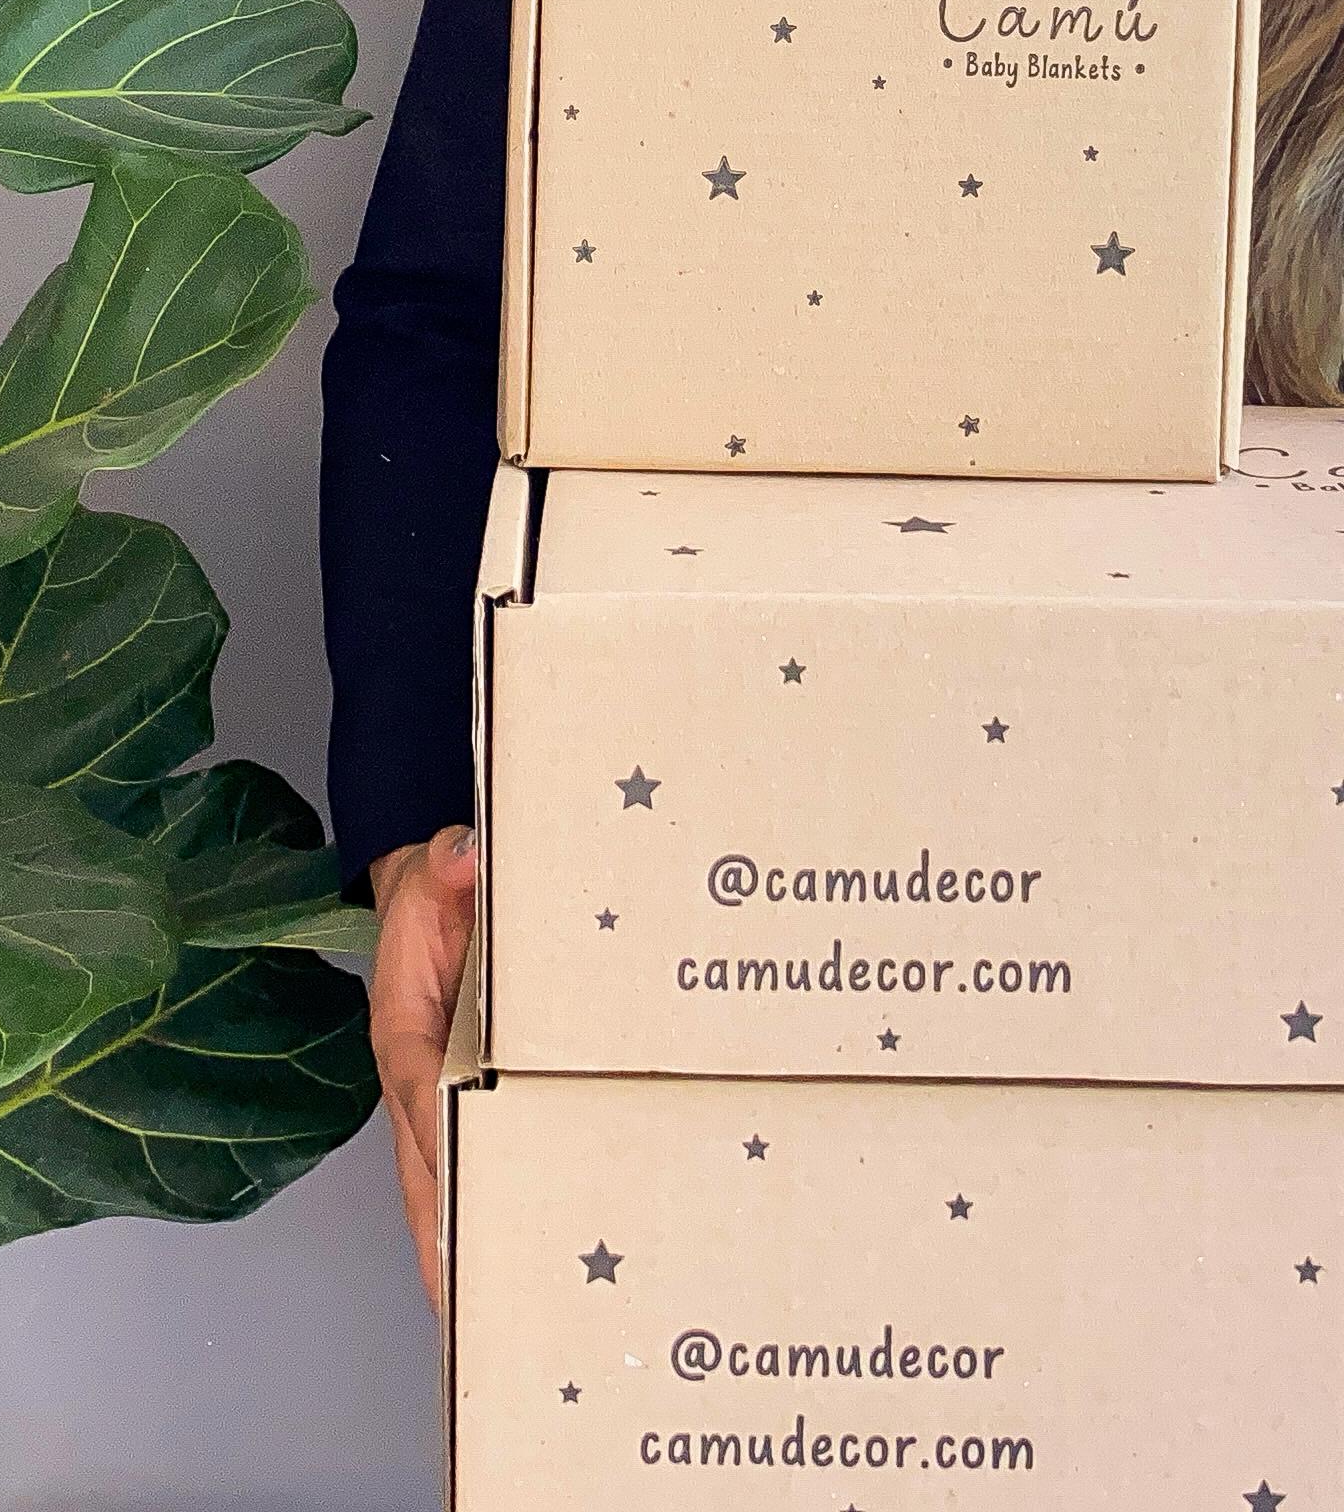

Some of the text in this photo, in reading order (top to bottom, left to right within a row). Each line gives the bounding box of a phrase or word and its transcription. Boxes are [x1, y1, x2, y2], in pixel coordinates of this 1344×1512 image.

[965, 51, 1122, 88] Baby Blankets
[707, 848, 1042, 906] @camudecor
[676, 939, 1072, 993] camudecor.com
[670, 1324, 1005, 1382] @camudecor
[640, 1414, 1034, 1470] camudecor.com
